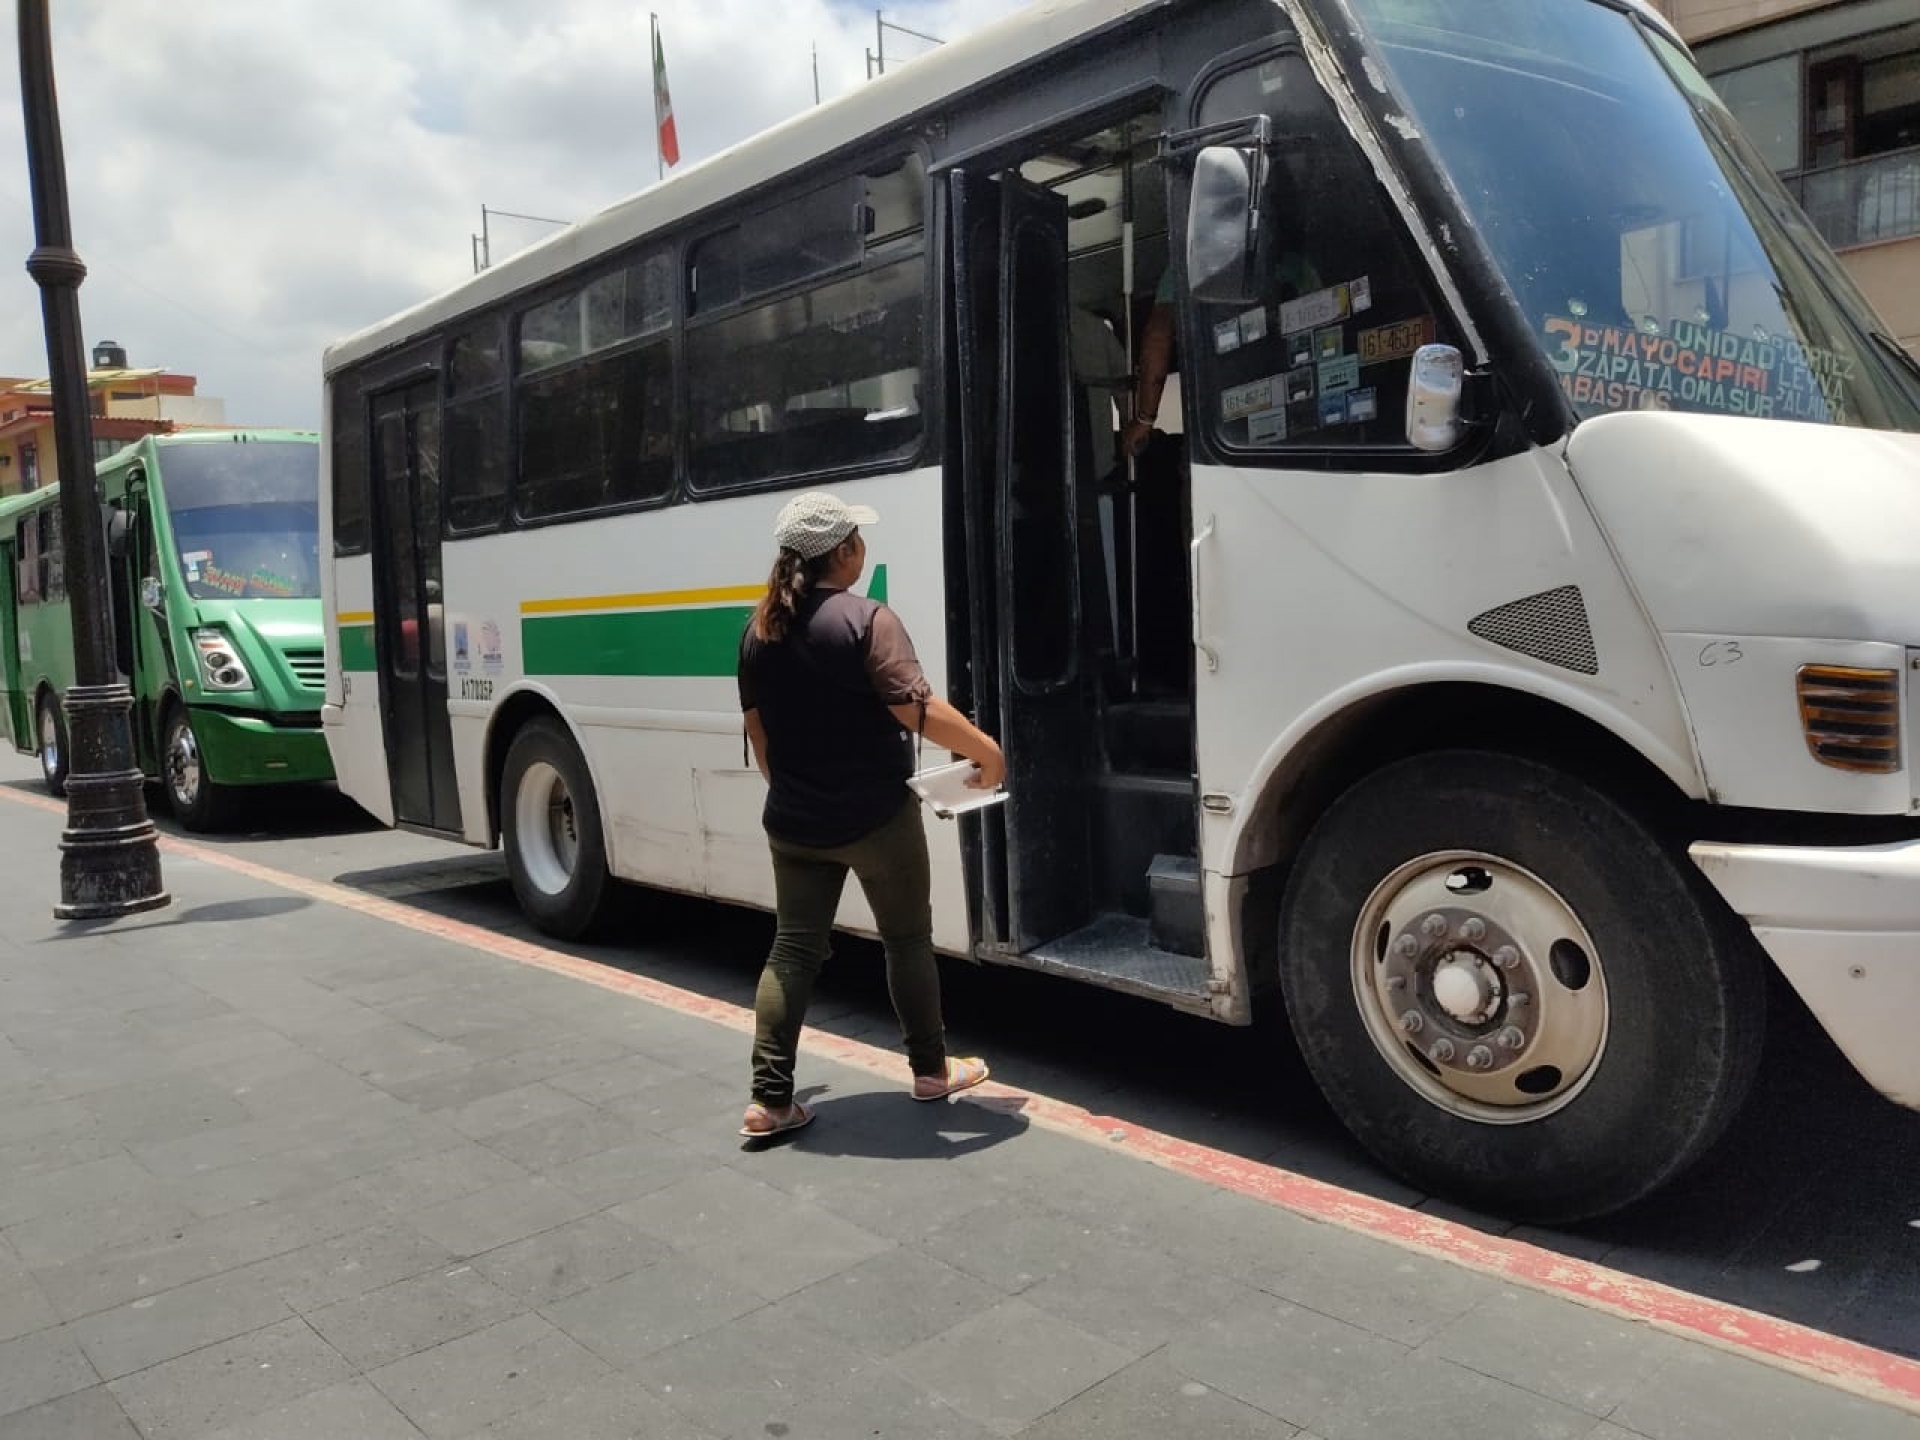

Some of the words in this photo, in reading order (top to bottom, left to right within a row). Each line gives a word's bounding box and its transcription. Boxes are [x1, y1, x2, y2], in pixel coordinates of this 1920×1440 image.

[1544, 317, 1582, 373] 3
[1674, 320, 1776, 370] UNIDAD
[1787, 340, 1856, 379] CORTEZ
[1577, 350, 1673, 391] ZAPATA
[1677, 348, 1768, 395] CAPIRI
[1779, 362, 1844, 400] LEYVA
[1560, 373, 1672, 411] ABASTOS
